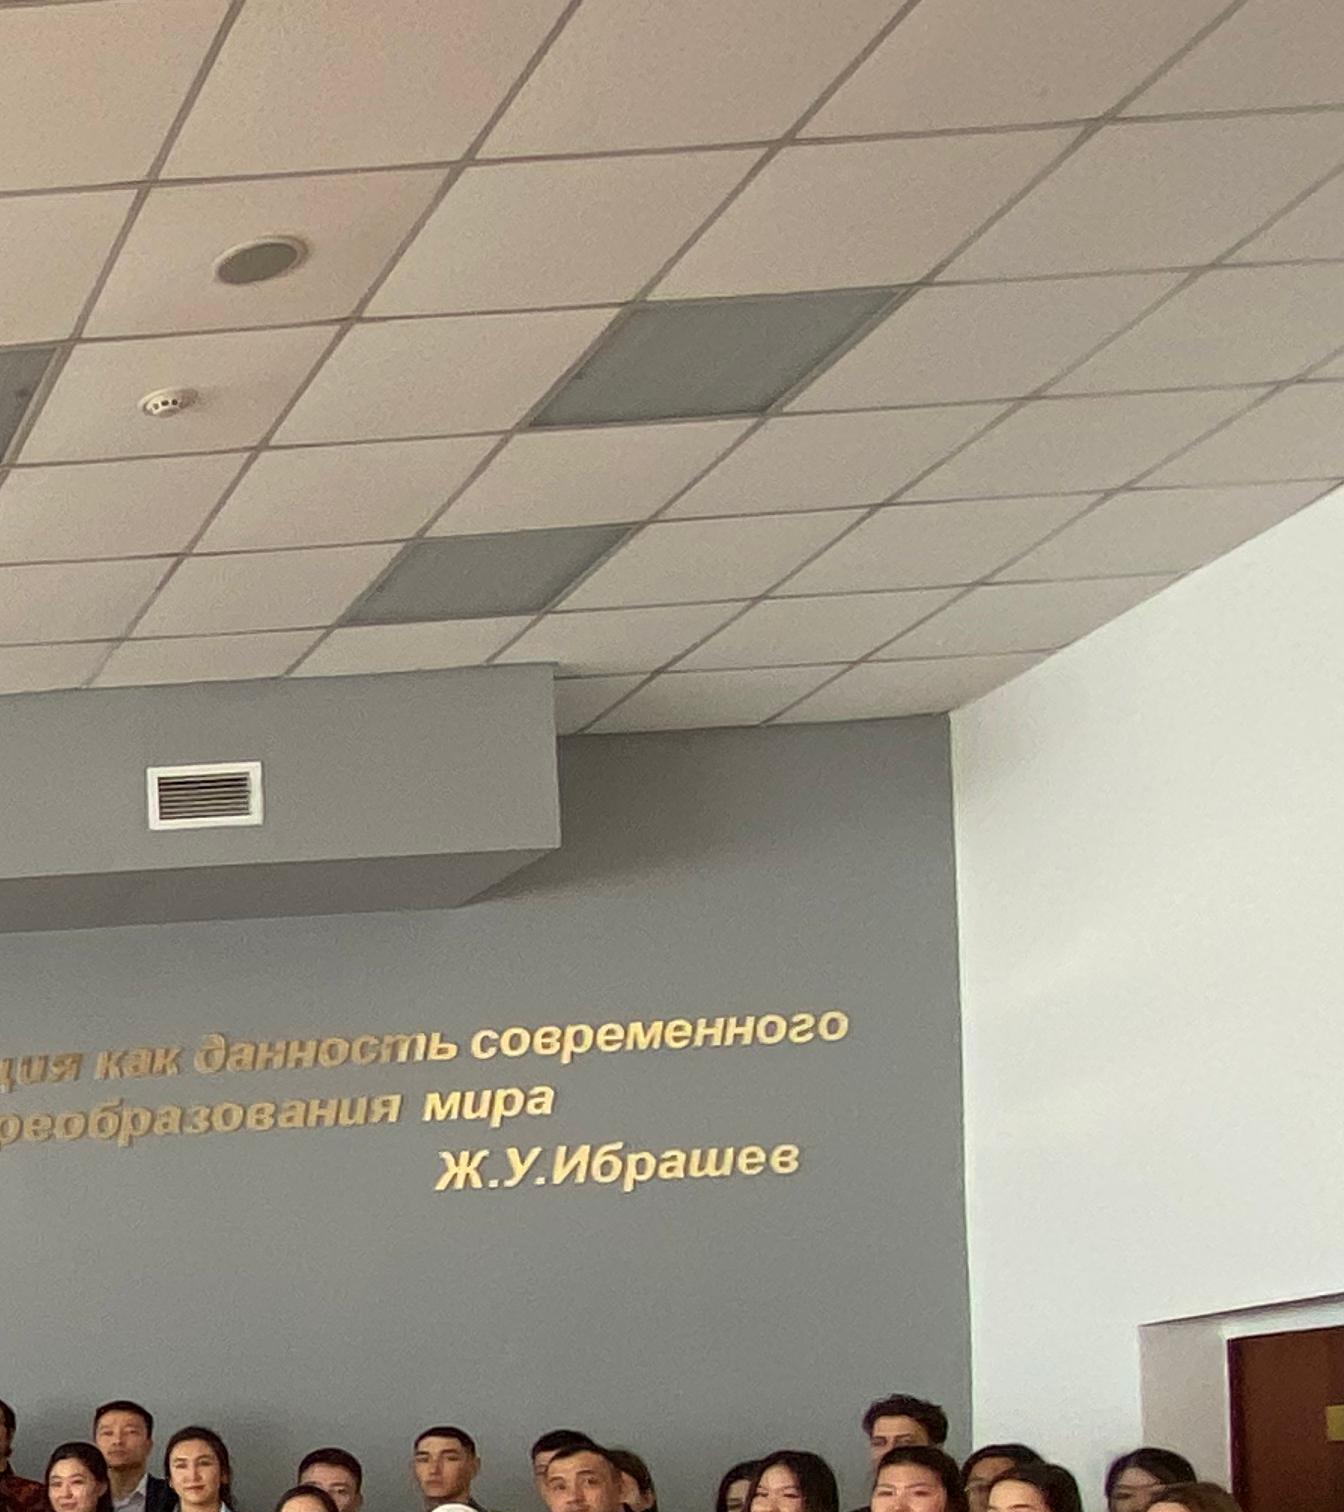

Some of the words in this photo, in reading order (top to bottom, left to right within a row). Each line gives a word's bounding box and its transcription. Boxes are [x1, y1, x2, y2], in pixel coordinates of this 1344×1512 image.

[95, 1046, 181, 1080] как
[195, 1030, 458, 1073] данность
[469, 1009, 850, 1064] современного
[421, 1083, 555, 1128] мира
[433, 1140, 801, 1193] Ж.У.Ибрашев
